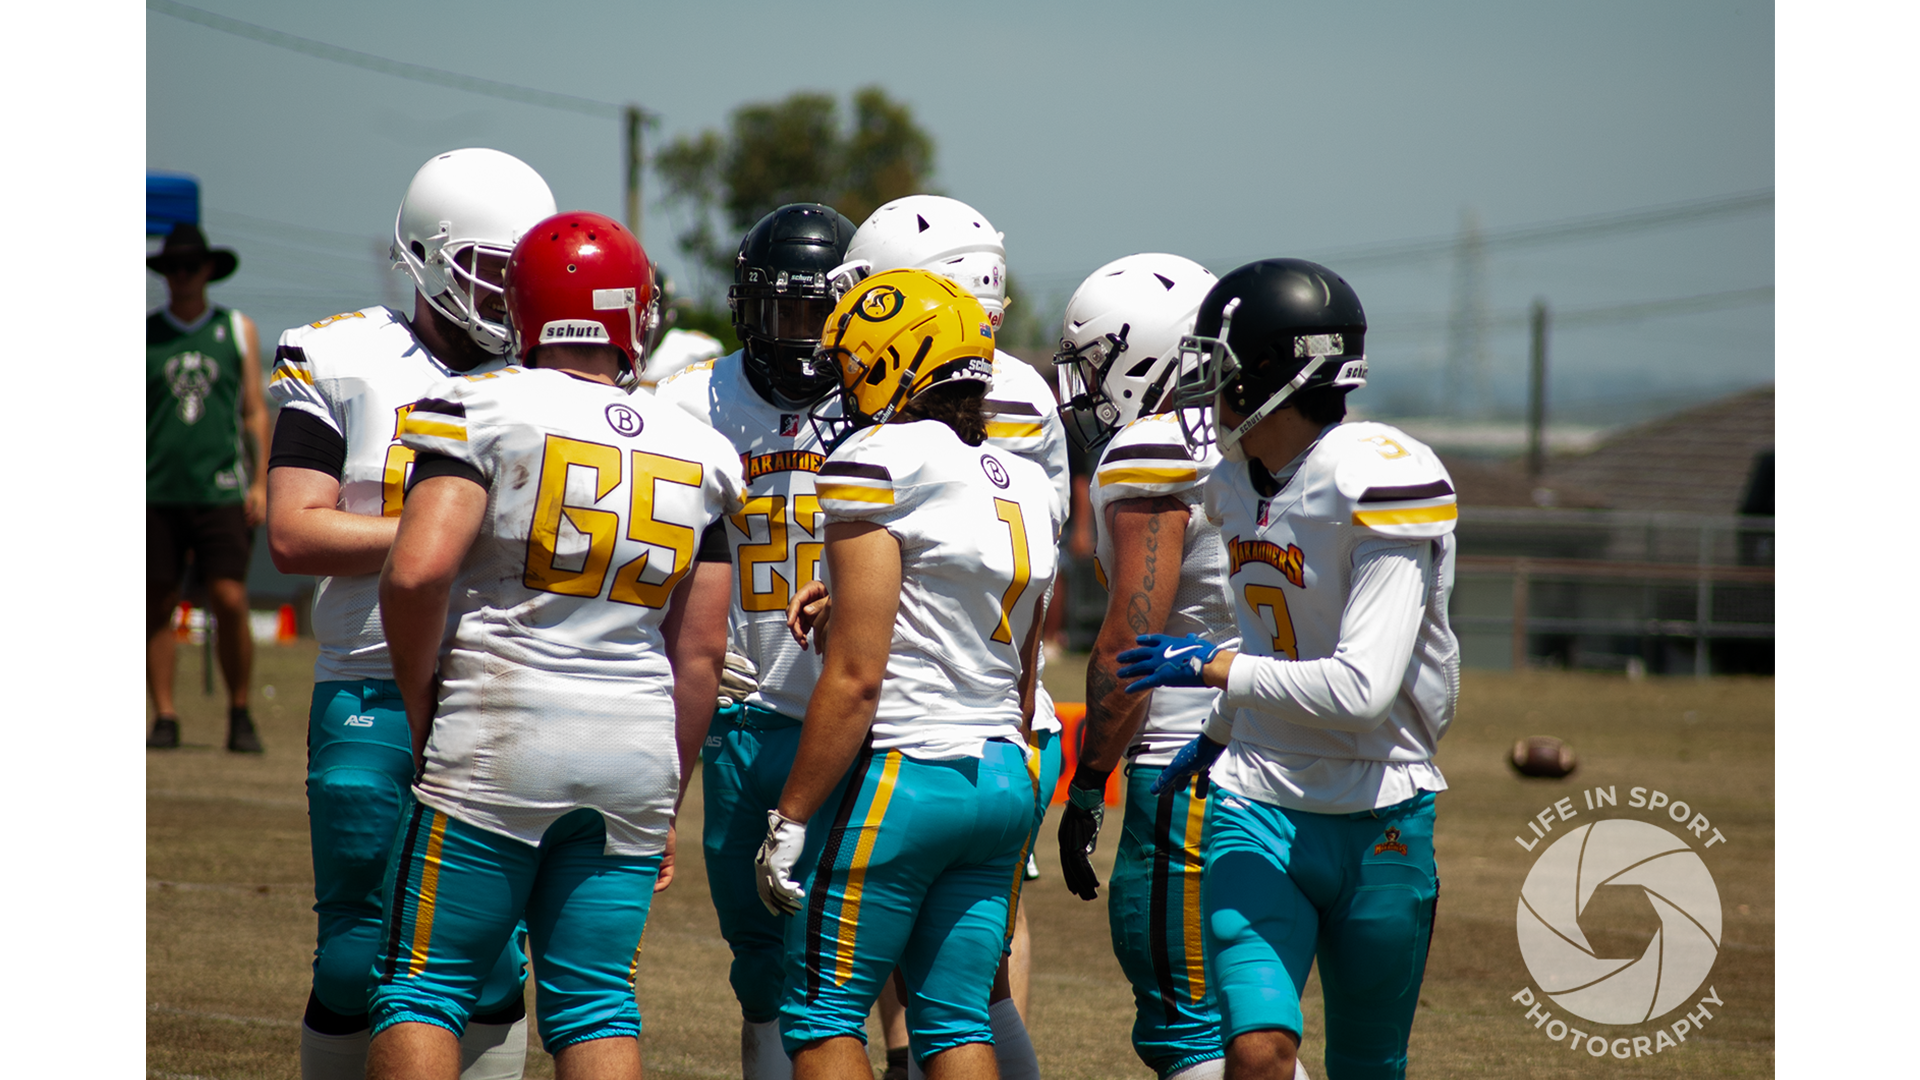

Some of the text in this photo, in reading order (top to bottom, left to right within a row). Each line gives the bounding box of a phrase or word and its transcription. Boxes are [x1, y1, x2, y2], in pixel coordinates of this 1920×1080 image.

[748, 272, 759, 282] 22
[791, 274, 813, 282] schutt
[546, 324, 600, 337] schutt
[880, 403, 895, 424] schutt
[1239, 411, 1263, 434] schutt
[739, 450, 828, 487] MARAUDE
[523, 433, 703, 610] 65
[990, 496, 1030, 645] 1
[1228, 534, 1306, 589] MARAUDERS
[343, 714, 375, 728] AS
[705, 735, 722, 747] AS
